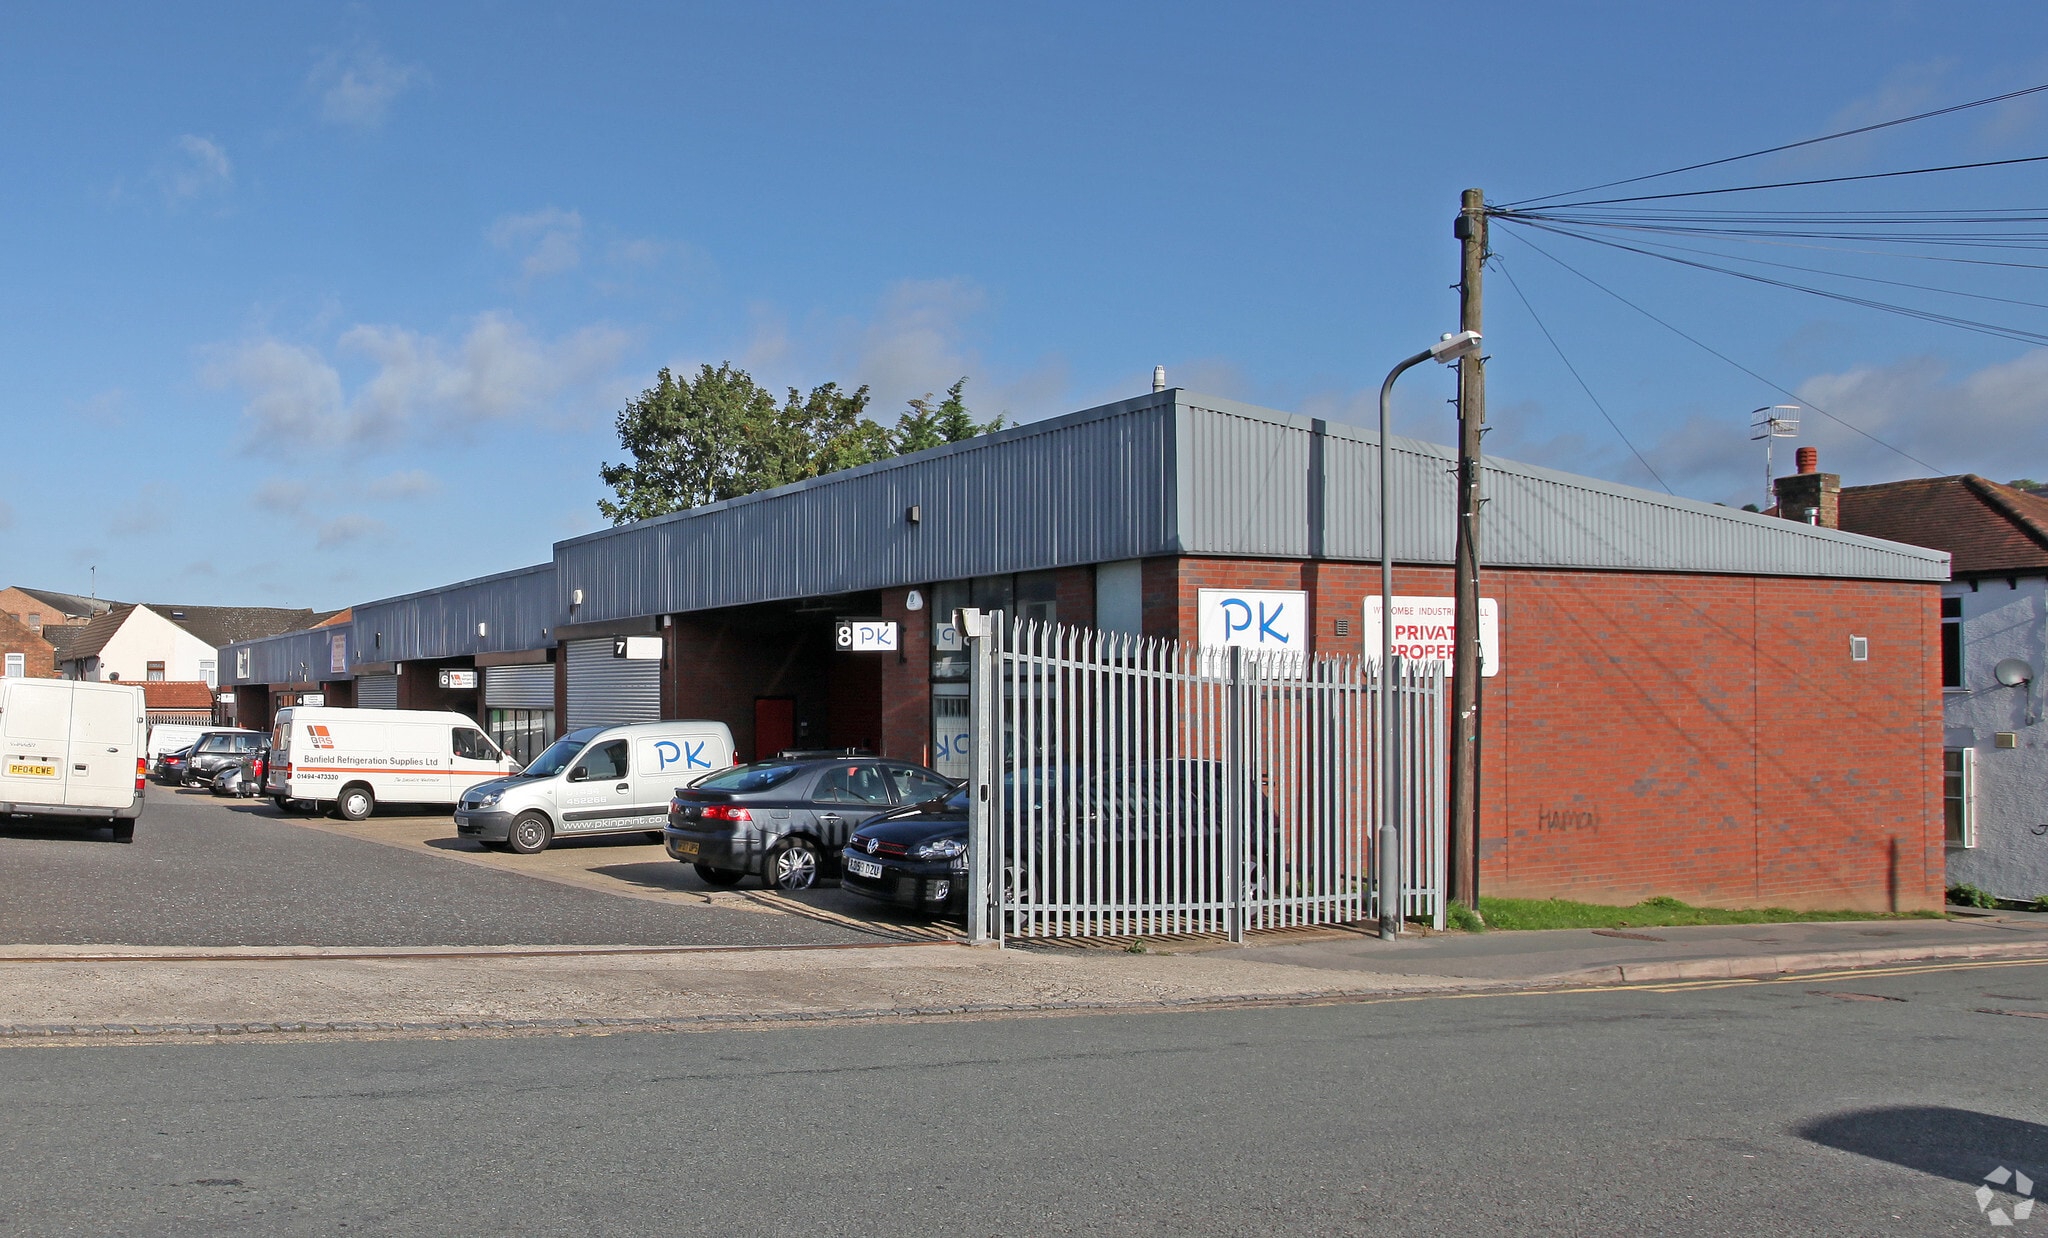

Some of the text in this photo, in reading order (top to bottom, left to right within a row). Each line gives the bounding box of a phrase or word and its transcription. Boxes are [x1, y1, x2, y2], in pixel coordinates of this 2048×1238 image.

[1373, 606, 1414, 616] WOMBE
[1418, 607, 1454, 617] INDUSTRI
[1220, 598, 1289, 644] PK
[837, 626, 852, 647] 8
[859, 627, 892, 646] PK
[1395, 625, 1456, 640] PRIVAT
[616, 641, 626, 655] 7
[1391, 644, 1455, 660] PROPER
[440, 674, 449, 685] 6
[216, 694, 221, 702] 2
[296, 697, 303, 705] 4
[310, 736, 333, 745] BRS
[304, 754, 439, 767] Banfield Refrigeration Supplies Ltd
[653, 740, 712, 772] PK
[11, 765, 34, 774] PF04
[296, 773, 339, 781] 01494-473330
